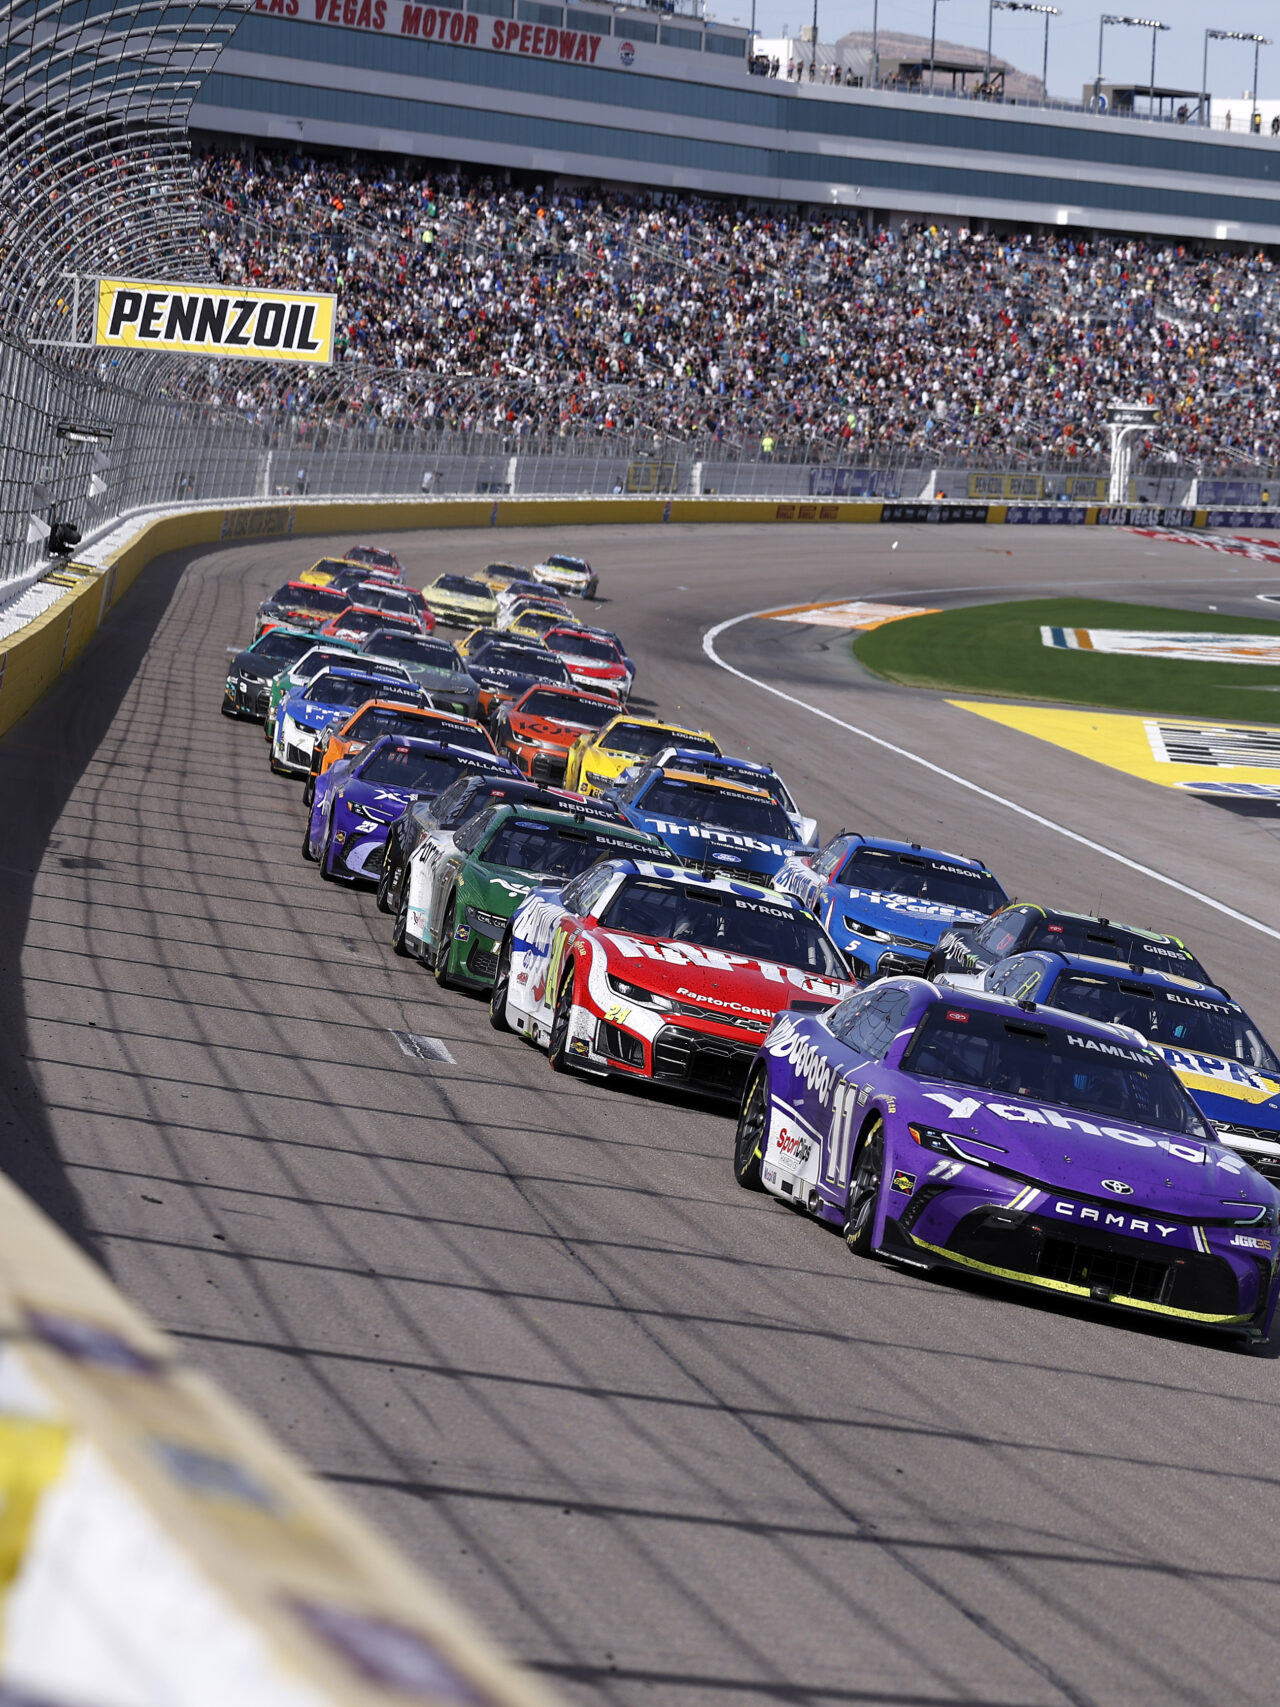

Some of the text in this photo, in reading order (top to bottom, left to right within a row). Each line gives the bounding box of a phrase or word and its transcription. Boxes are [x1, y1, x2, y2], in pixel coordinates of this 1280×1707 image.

[314, 0, 388, 30] VEGAS
[401, 7, 479, 45] MOTOR
[492, 21, 602, 63] SPEEDWAY
[108, 290, 320, 351] PENNZOIL
[1108, 508, 1182, 527] LAS VEGAS USA
[374, 664, 404, 675] JONES
[239, 682, 248, 693] 3
[579, 698, 622, 713] CHASTAIN
[441, 721, 478, 735] PREECE
[671, 731, 707, 743] LOGANO
[457, 756, 513, 775] WALLACE
[738, 768, 767, 780] SMITH
[558, 801, 616, 820] REDDICK
[354, 820, 379, 834] 23
[595, 835, 670, 858] BUESCHER
[931, 862, 982, 880] LARSON
[735, 899, 795, 921] BYRON
[844, 939, 862, 952] 5
[1142, 943, 1187, 962] GIBBS
[1165, 992, 1231, 1016] ELLIOTT
[604, 1004, 632, 1025] 24
[1067, 1034, 1154, 1067] HAMLIN
[1161, 1047, 1263, 1090] APA
[927, 1159, 966, 1181] 11
[1054, 1201, 1178, 1238] CAMRY
[1229, 1234, 1273, 1251] JGR35
